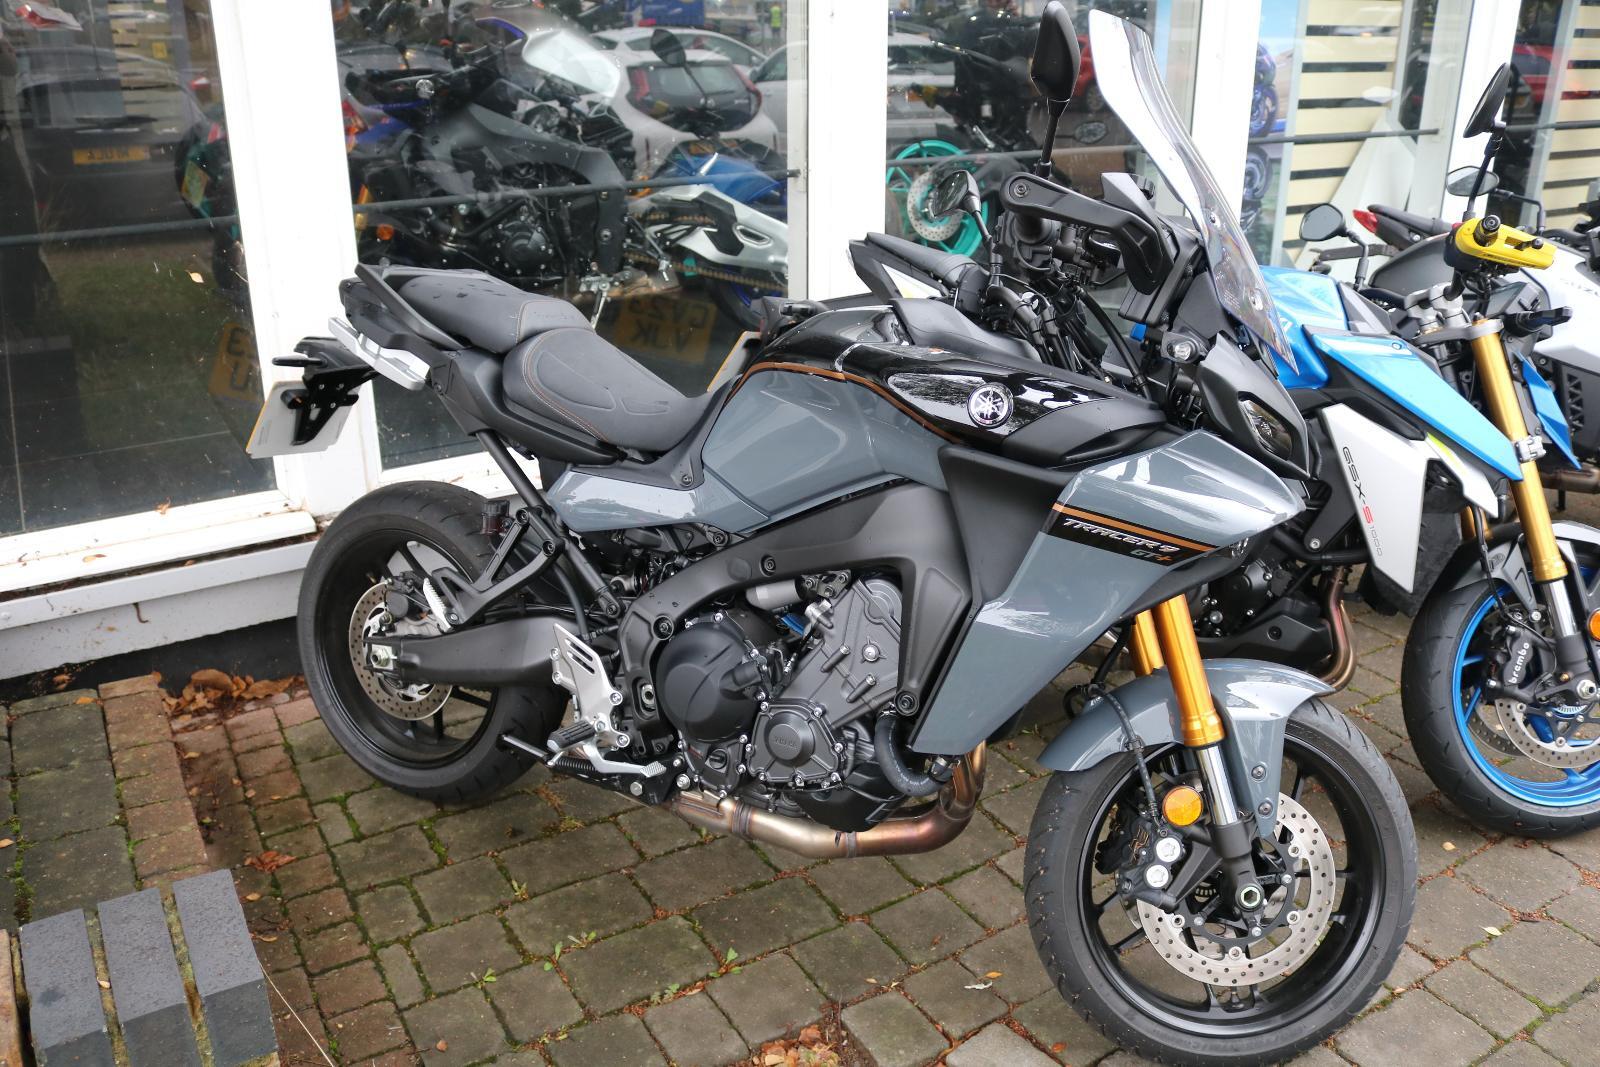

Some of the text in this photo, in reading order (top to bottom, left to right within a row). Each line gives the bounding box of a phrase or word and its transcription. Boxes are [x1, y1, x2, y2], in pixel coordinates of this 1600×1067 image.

[1063, 518, 1161, 549] TRACER
[1369, 525, 1383, 556] 1000
[1508, 642, 1530, 684] brembo
